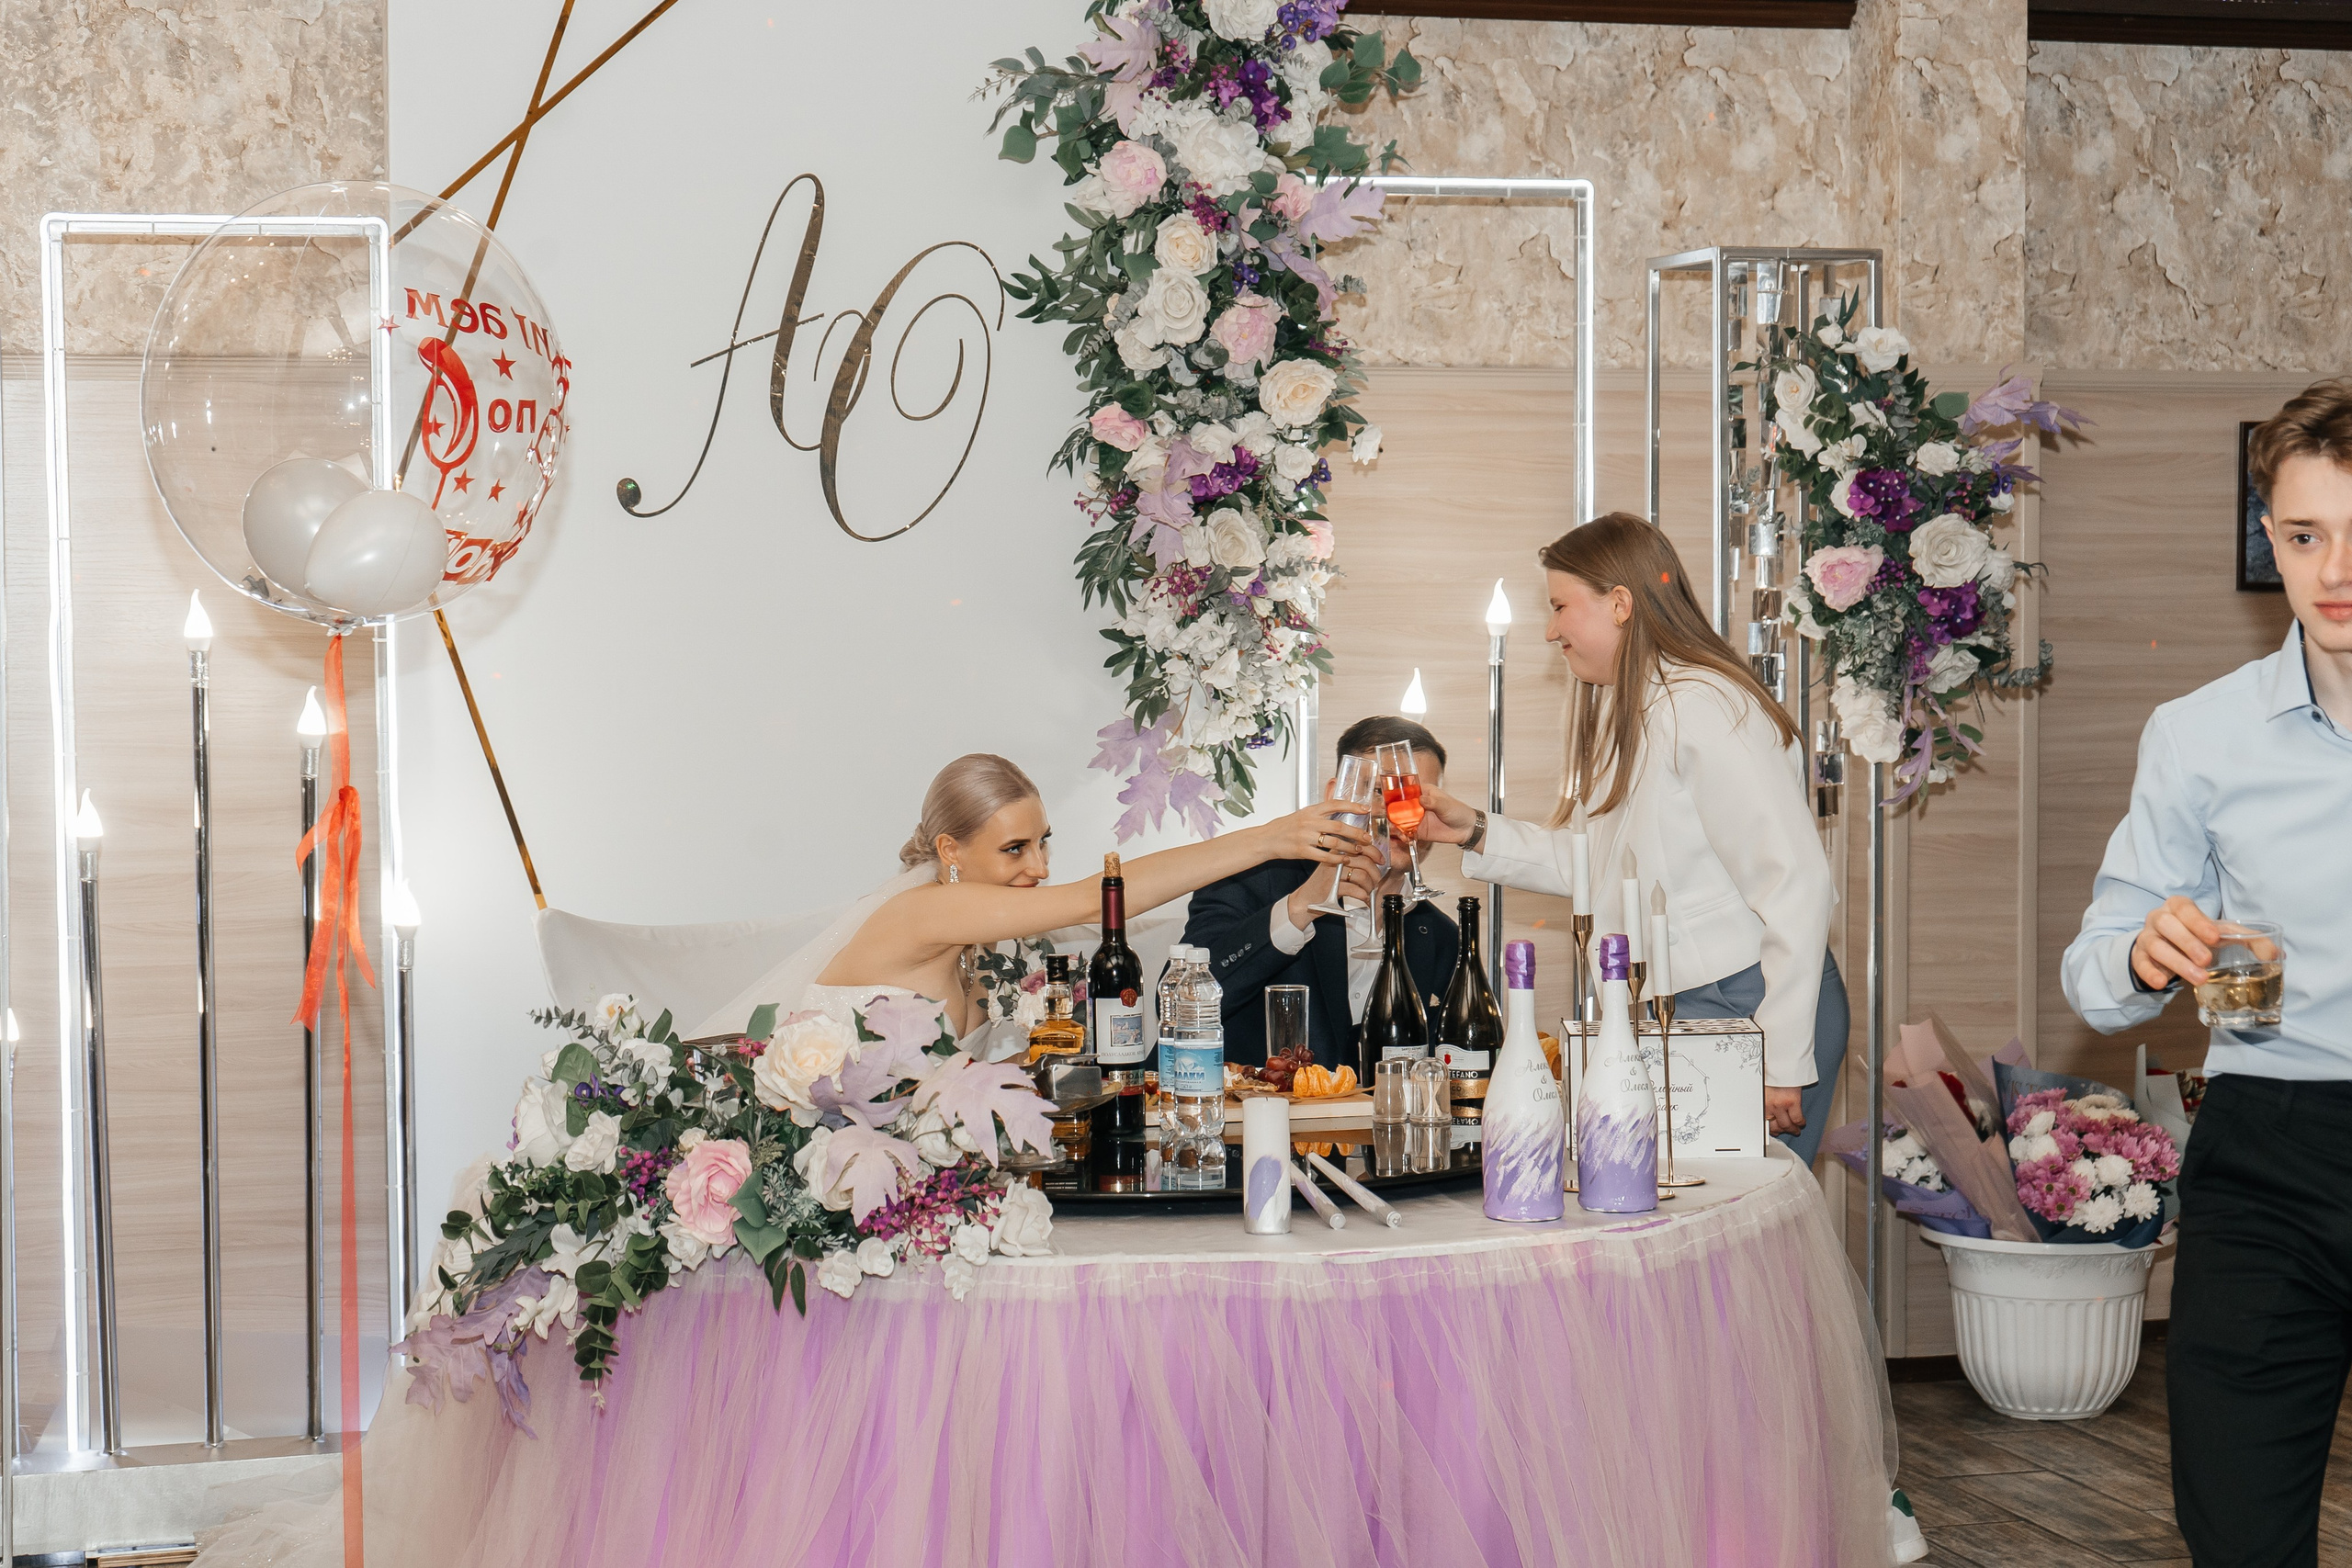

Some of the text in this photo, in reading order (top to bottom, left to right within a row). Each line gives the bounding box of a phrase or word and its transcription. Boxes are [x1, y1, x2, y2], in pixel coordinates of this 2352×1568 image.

[1449, 1070, 1478, 1079] TEFANO
[1621, 1078, 1649, 1093] Олеся
[1650, 1079, 1694, 1093] емйный
